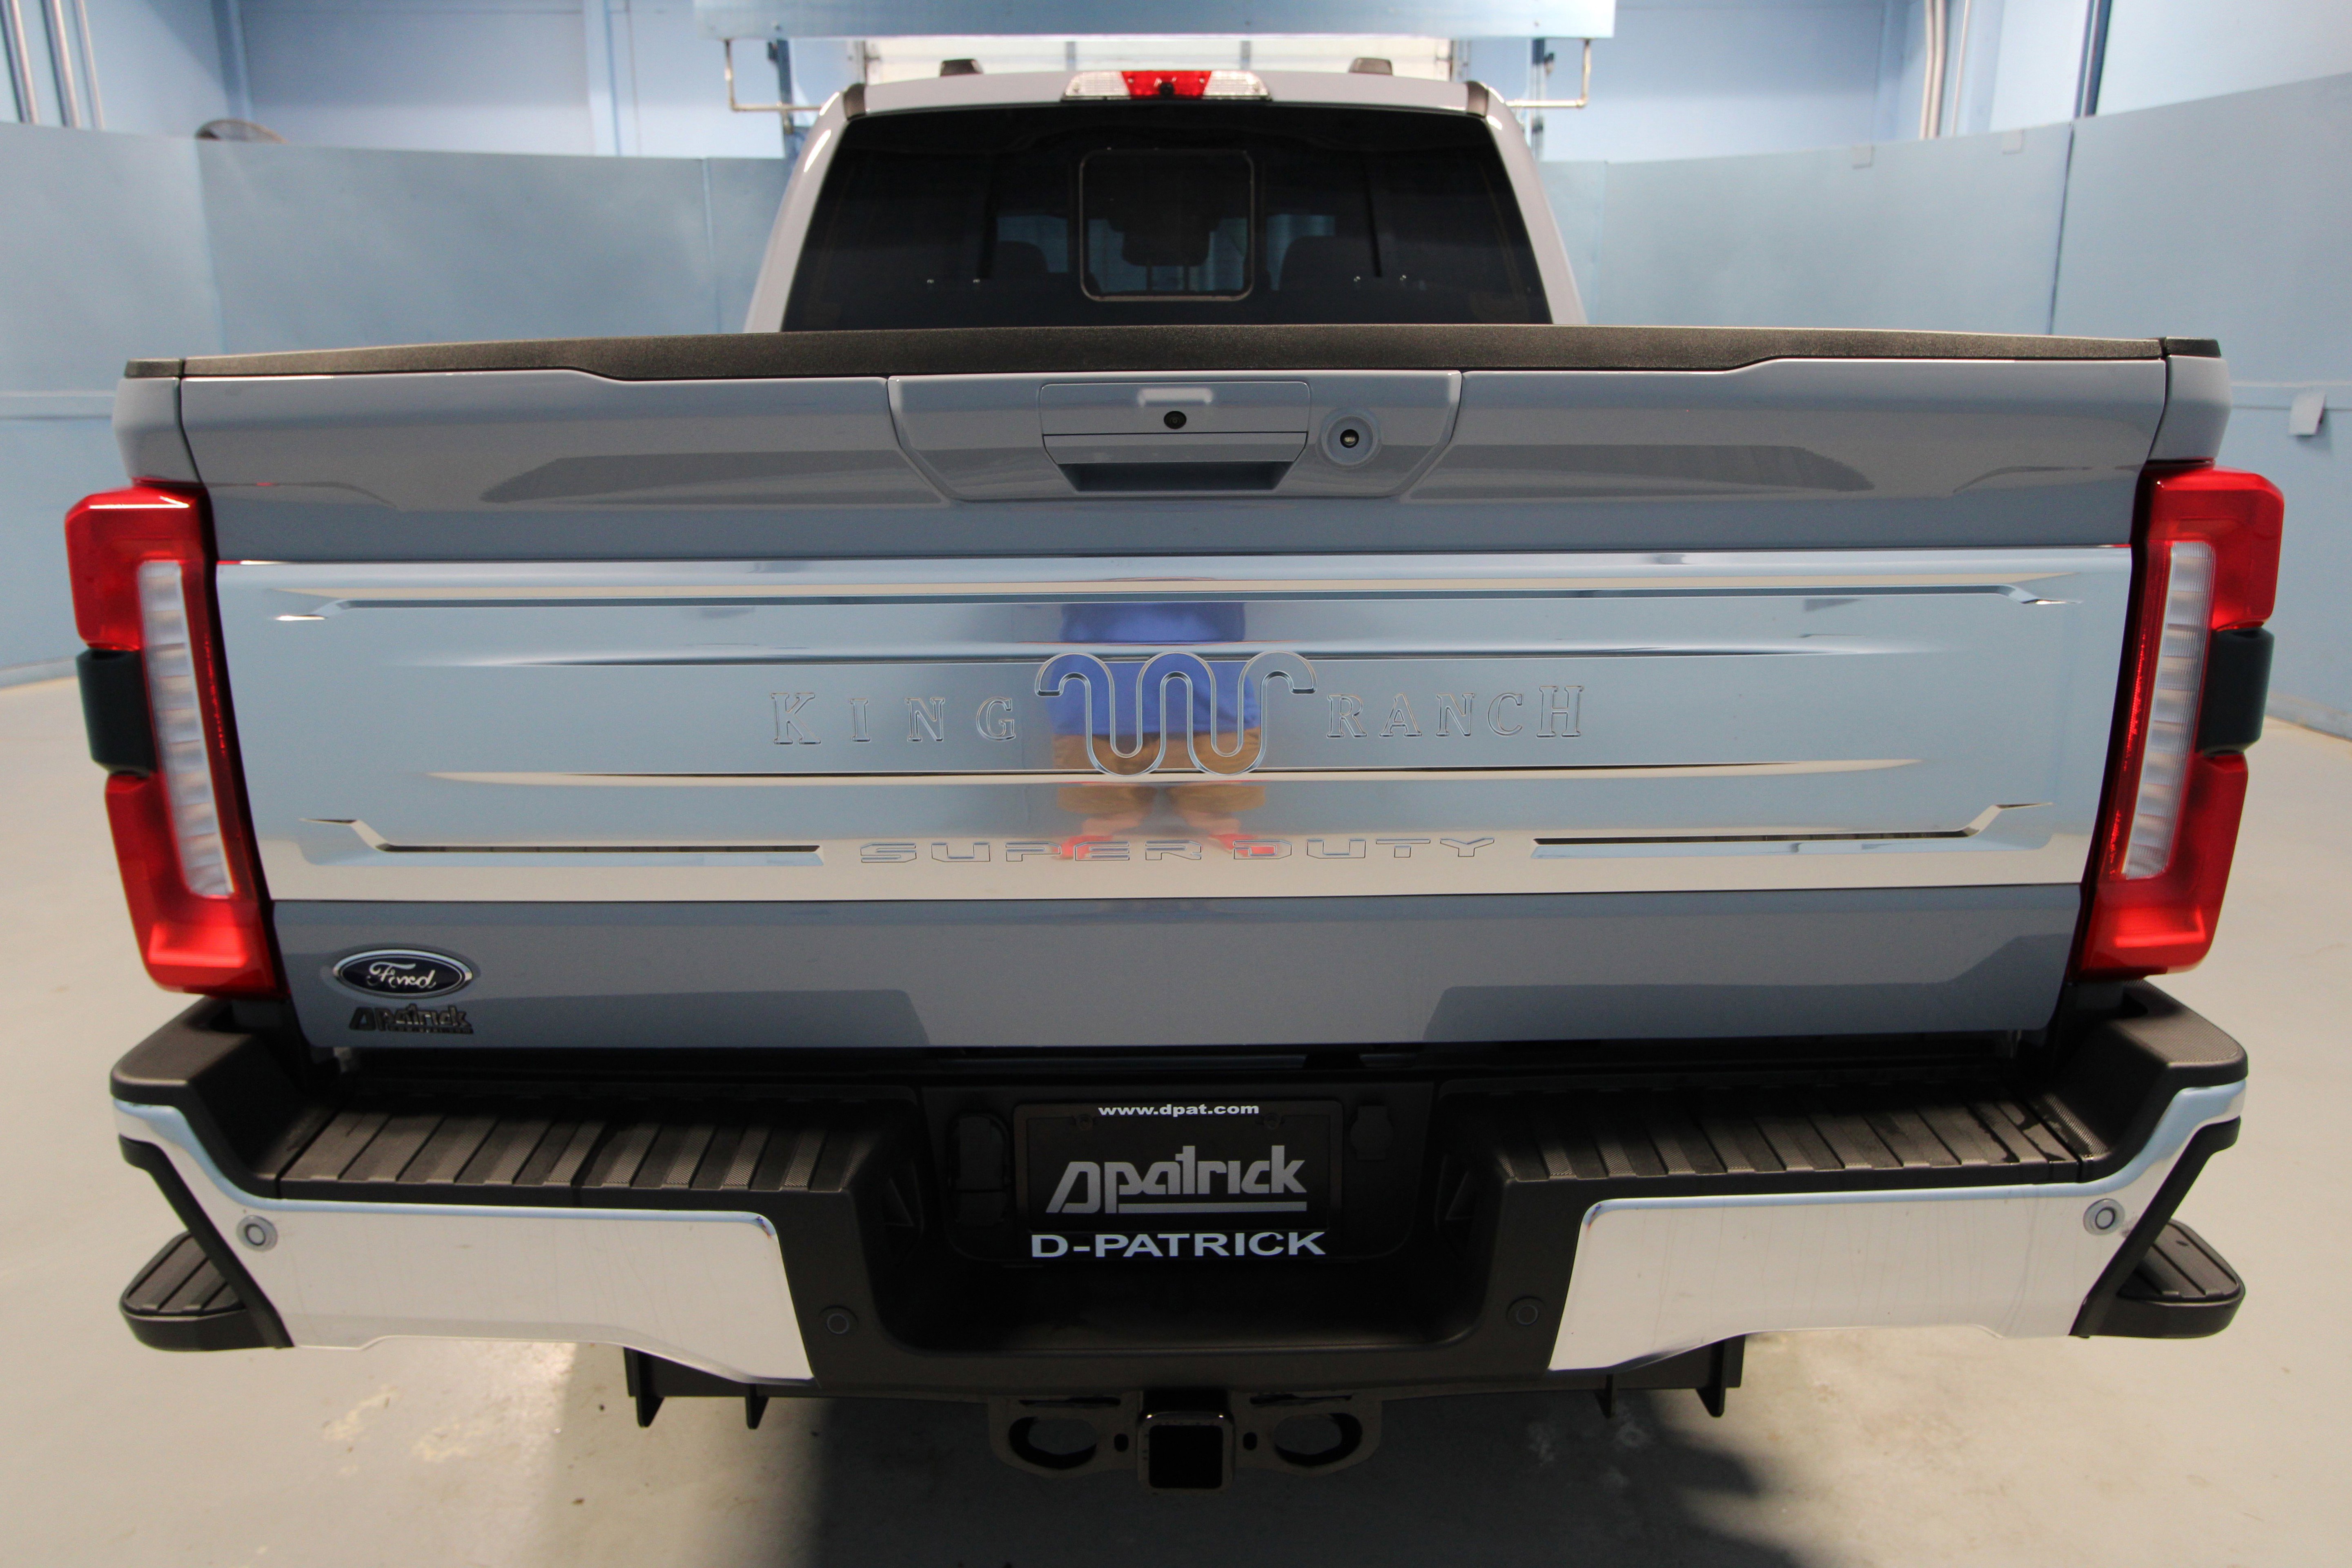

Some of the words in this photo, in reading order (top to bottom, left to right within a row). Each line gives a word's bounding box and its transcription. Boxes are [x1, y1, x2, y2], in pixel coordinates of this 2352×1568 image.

[770, 692, 1017, 745] KING
[1326, 685, 1584, 738] RANCH
[860, 840, 1202, 864] SUPER
[1234, 837, 1495, 860] DUTY
[367, 961, 437, 989] Ford
[1098, 1104, 1260, 1117] www.dpat.com
[1031, 1232, 1326, 1258] D-PATRICK
